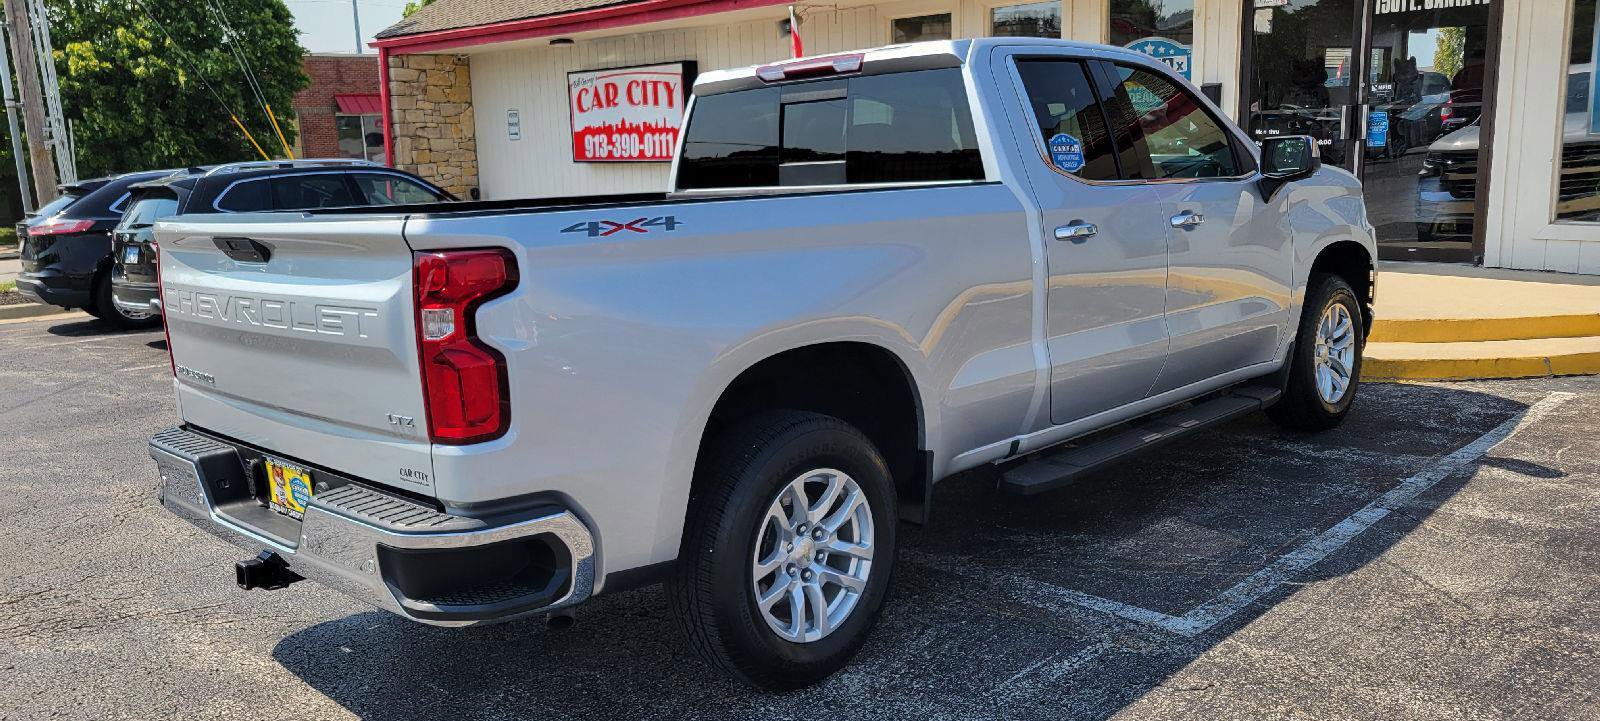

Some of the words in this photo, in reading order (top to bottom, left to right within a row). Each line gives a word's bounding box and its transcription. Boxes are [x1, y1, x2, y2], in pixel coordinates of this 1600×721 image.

[576, 81, 619, 114] CAR
[626, 79, 676, 109] CITY
[584, 132, 674, 159] 913-390-0111
[164, 287, 378, 338] CHEVROLET
[386, 412, 415, 428] LTZ
[399, 467, 413, 478] CAR
[414, 470, 429, 482] CITY
